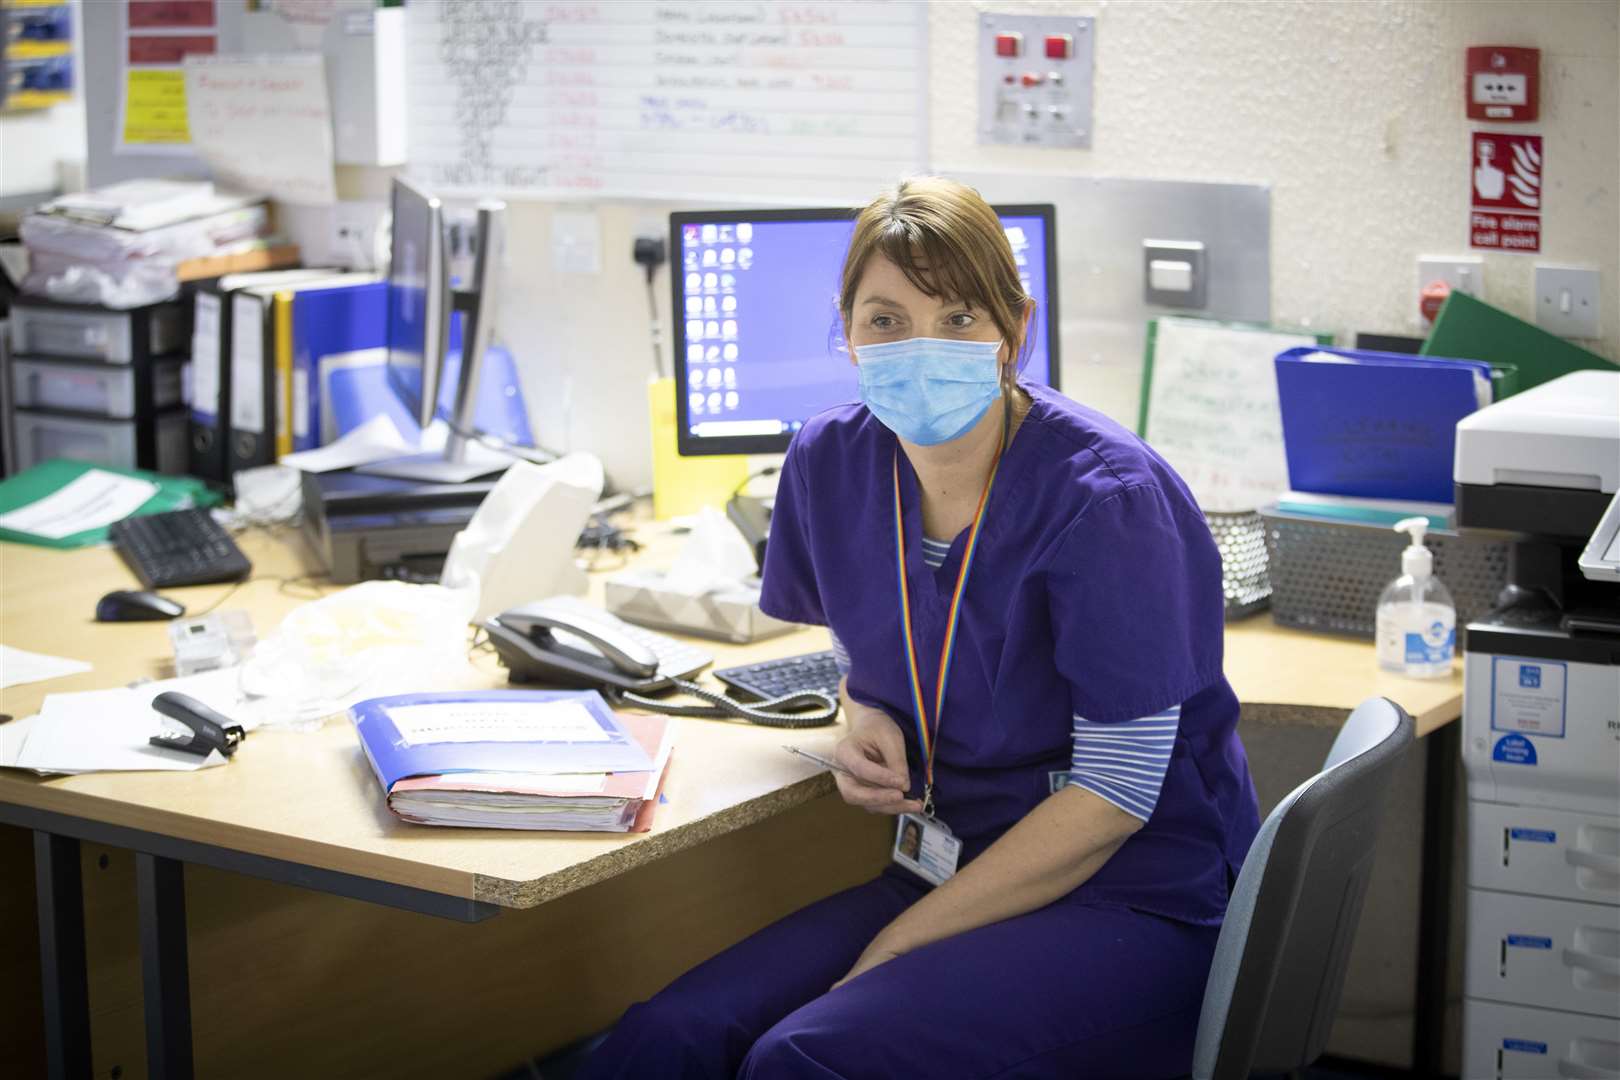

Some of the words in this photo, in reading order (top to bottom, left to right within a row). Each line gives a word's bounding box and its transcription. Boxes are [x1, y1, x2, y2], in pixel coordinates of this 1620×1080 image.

[1473, 214, 1497, 229] Fire
[1502, 217, 1538, 231] alarm
[1474, 231, 1497, 245] call
[1502, 235, 1536, 249] point
